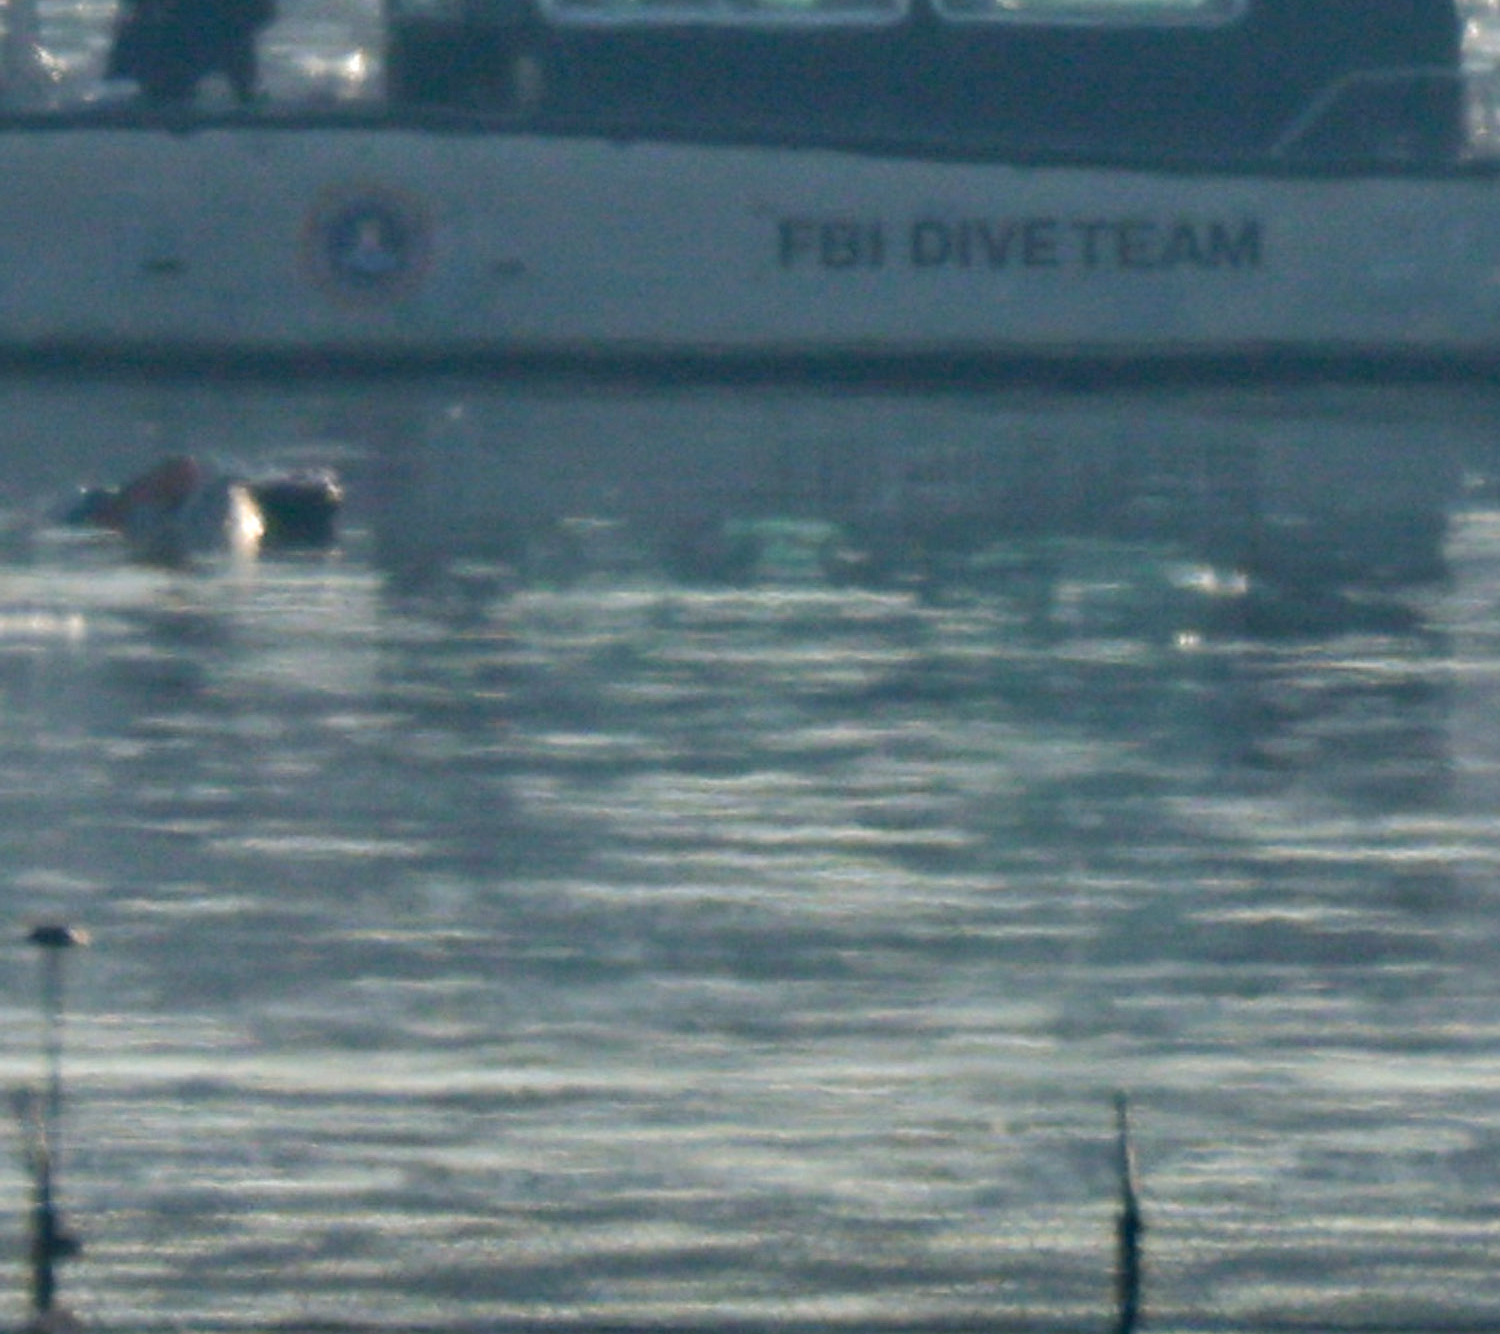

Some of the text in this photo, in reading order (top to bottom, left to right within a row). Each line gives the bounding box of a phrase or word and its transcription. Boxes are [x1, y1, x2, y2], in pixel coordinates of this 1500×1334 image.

[778, 218, 1264, 268] FBI DIVE TEAM
